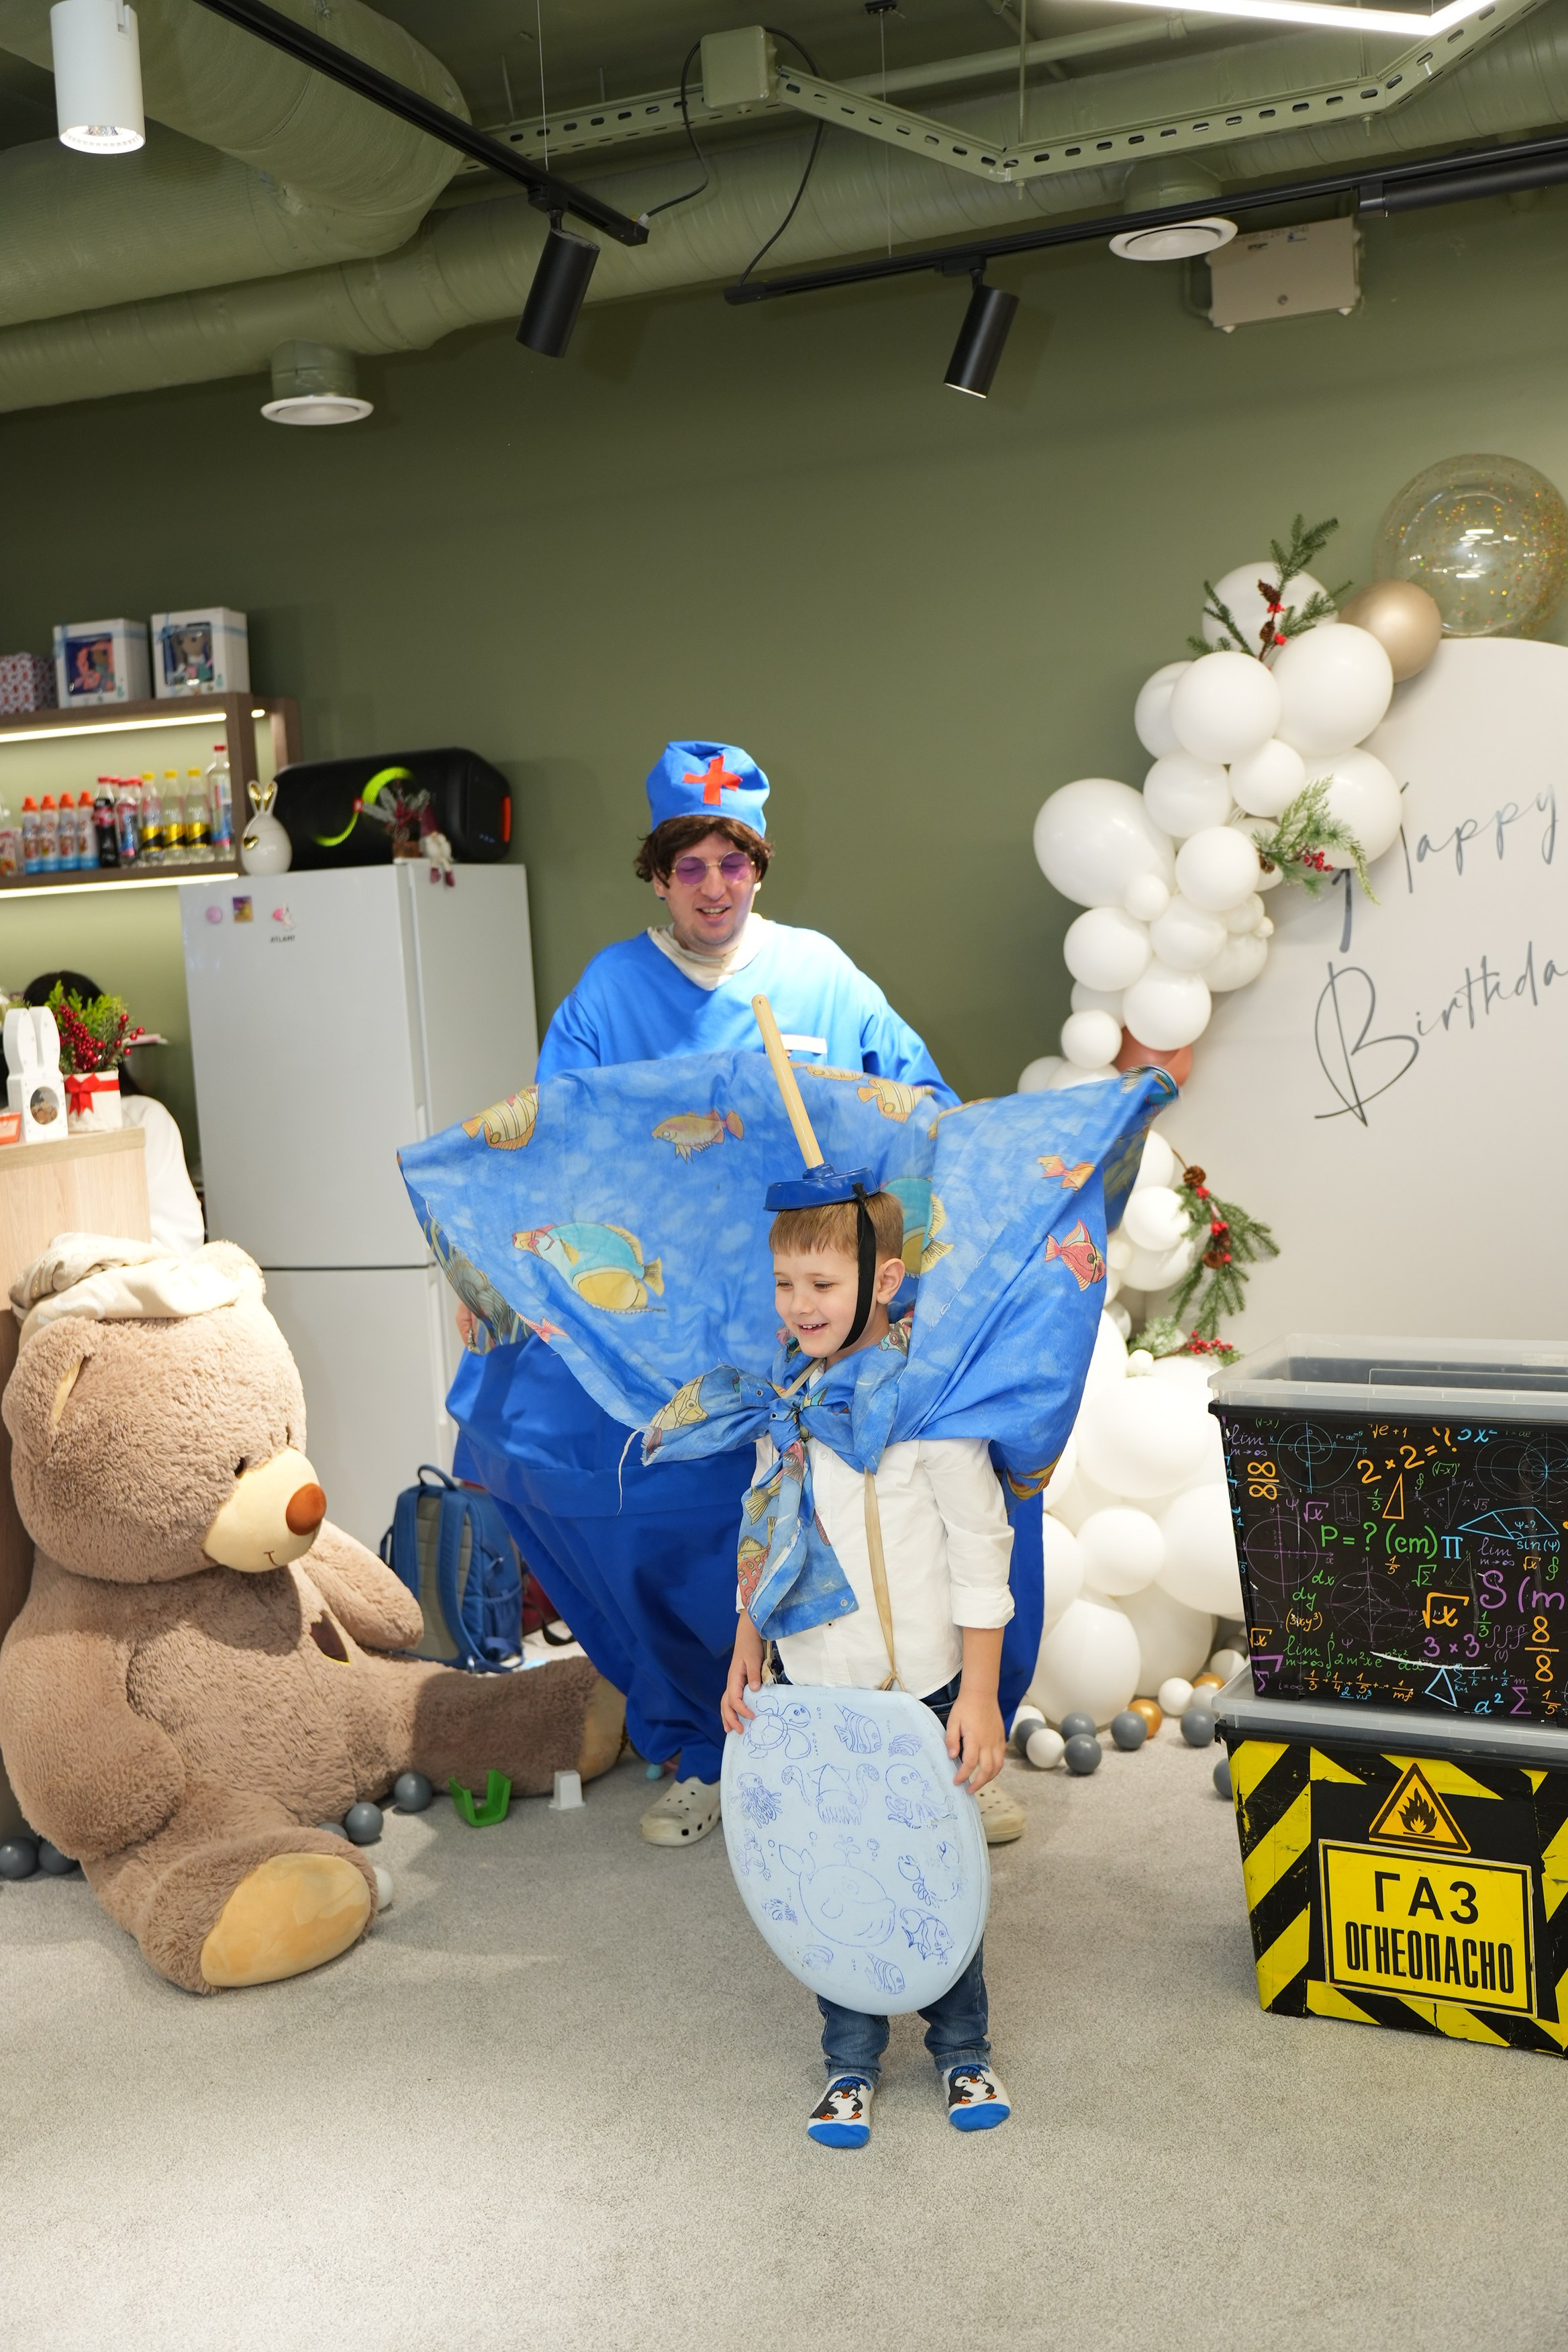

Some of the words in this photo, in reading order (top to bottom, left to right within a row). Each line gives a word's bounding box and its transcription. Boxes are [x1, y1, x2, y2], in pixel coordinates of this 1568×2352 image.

[1314, 941, 1568, 1127] Birthda
[1375, 1870, 1479, 1924] ГАЗ
[1345, 1921, 1514, 1994] ОГНЕОПАСНО
